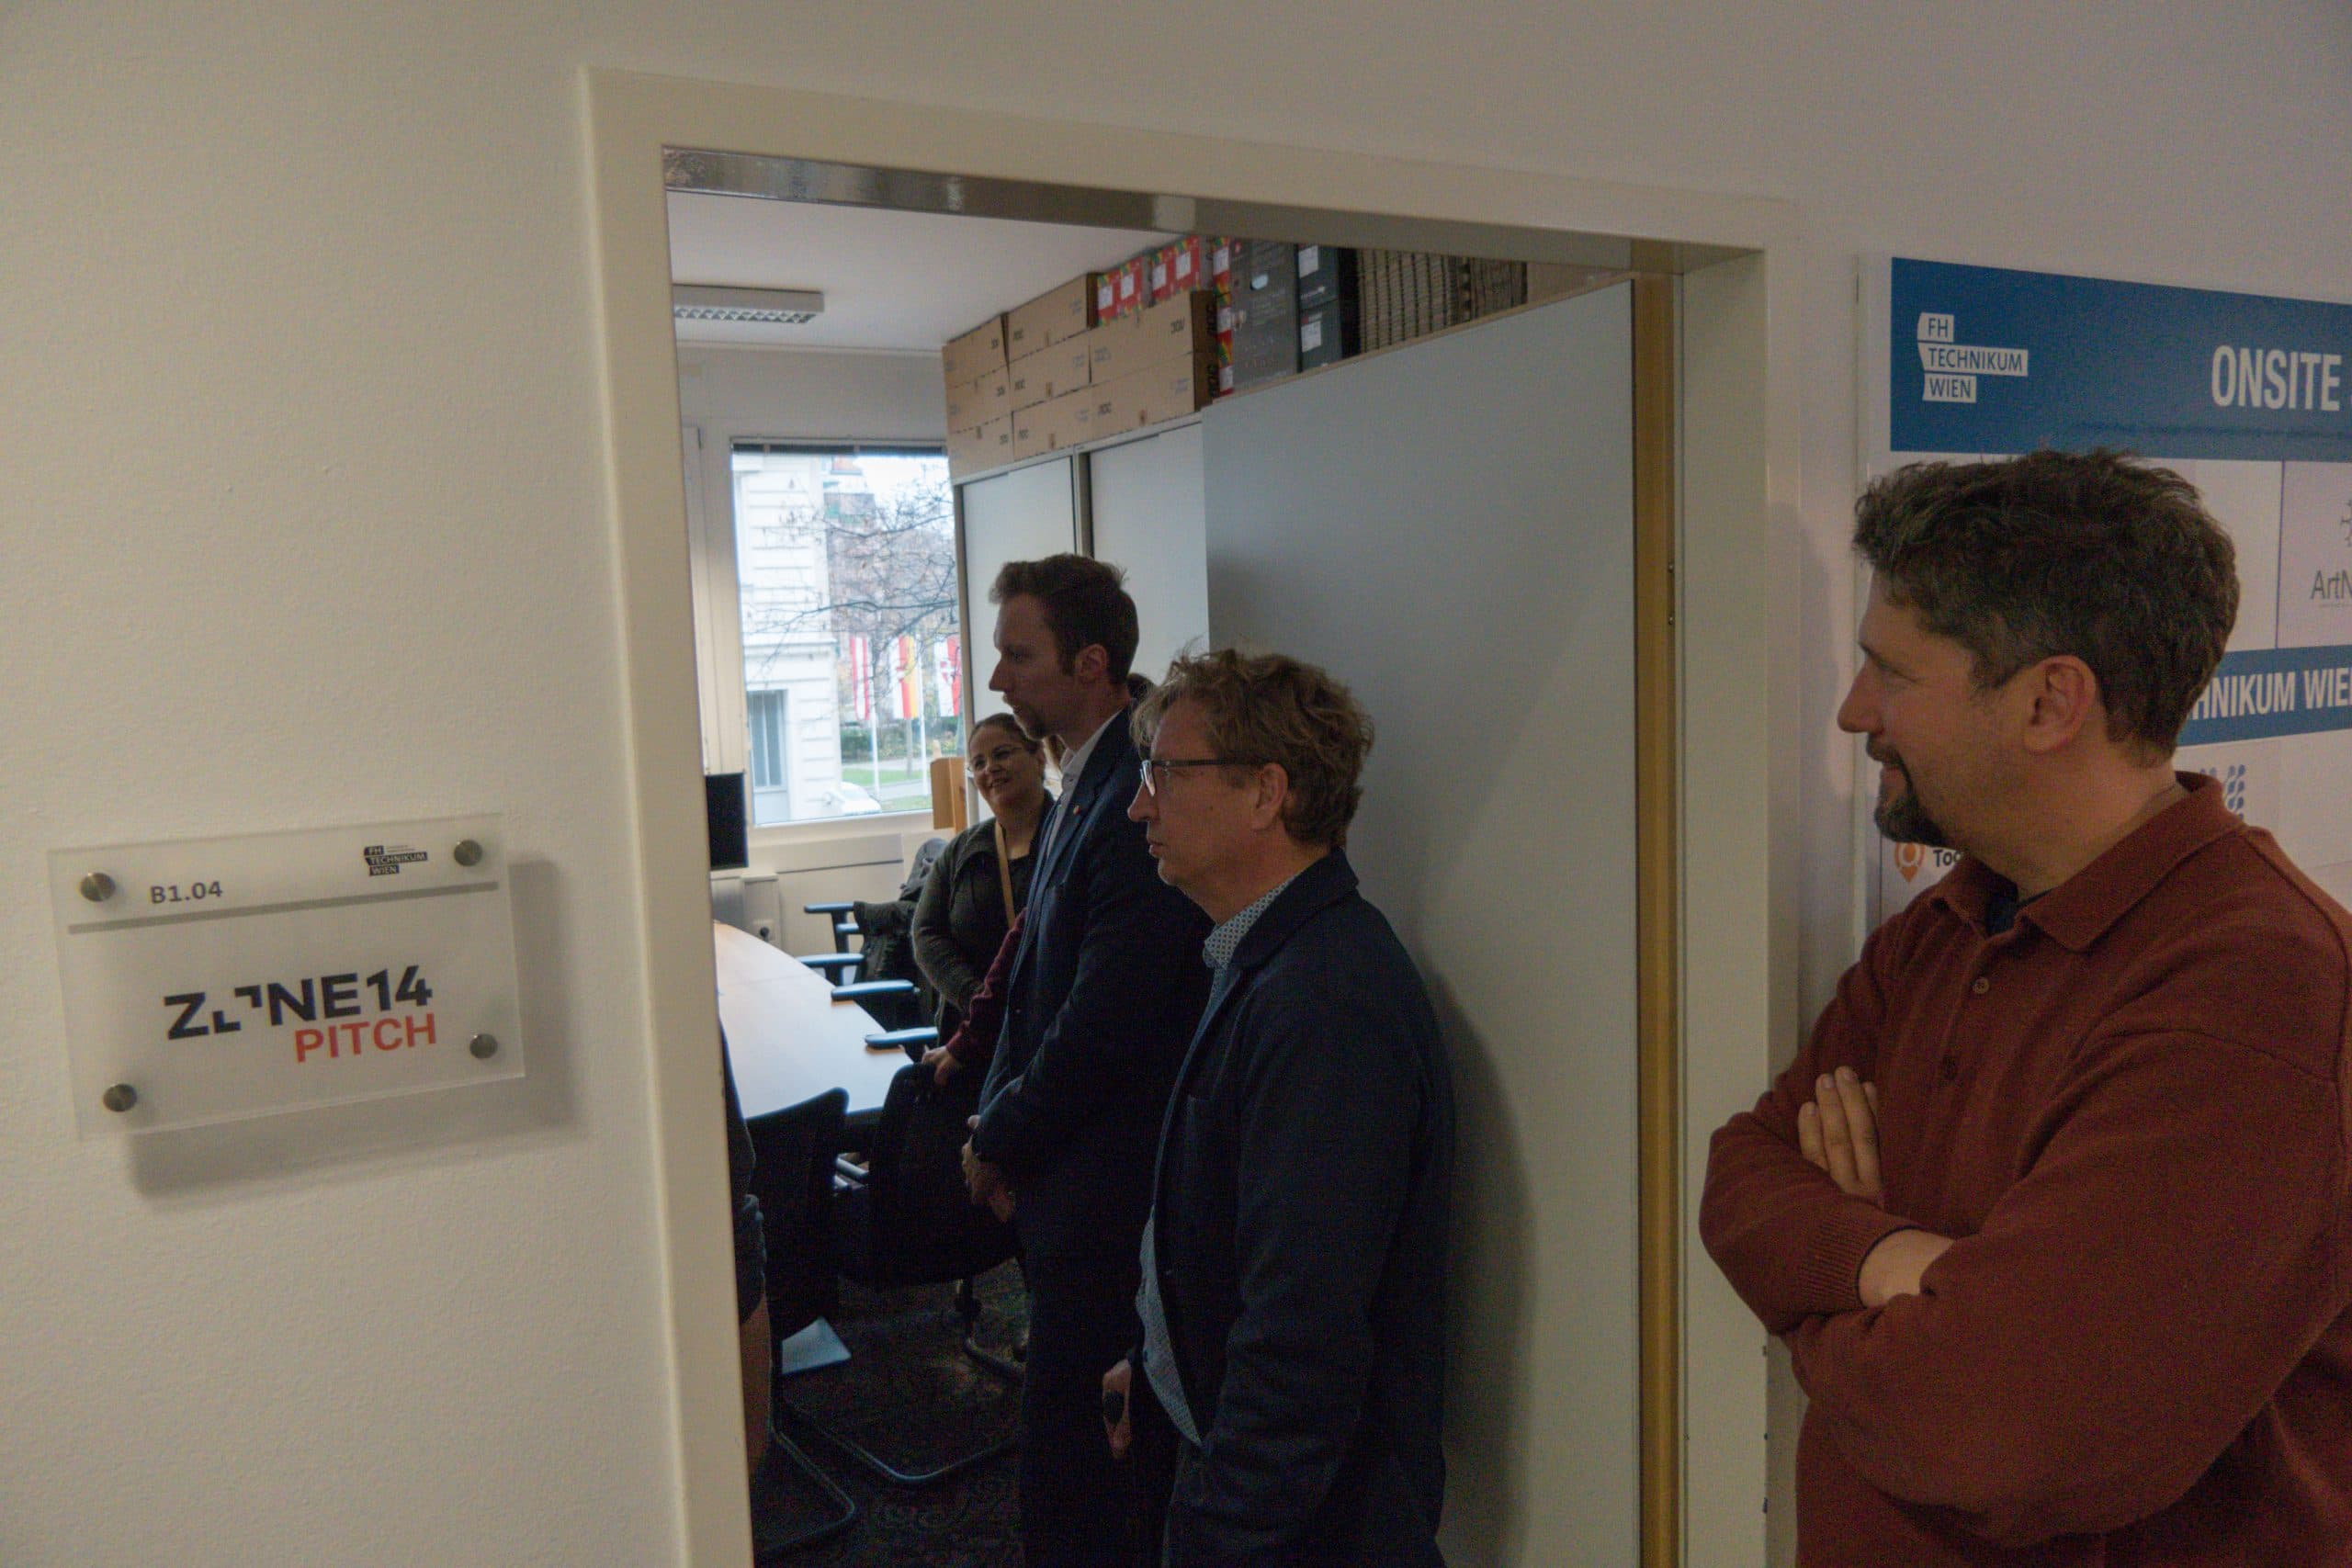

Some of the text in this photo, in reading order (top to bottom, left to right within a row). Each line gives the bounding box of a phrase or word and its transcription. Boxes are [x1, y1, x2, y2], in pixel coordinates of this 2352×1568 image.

[1928, 317, 1949, 338] FH
[1928, 347, 2022, 372] TECHNIKUM
[1929, 378, 1972, 399] WIEN
[2211, 344, 2342, 412] ONSITE
[2187, 666, 2352, 721] HNIKUM WIE
[369, 852, 426, 866] TECHNIKUM
[371, 864, 398, 875] WIEN
[150, 880, 224, 905] B1.04
[294, 1012, 437, 1064] PITCH
